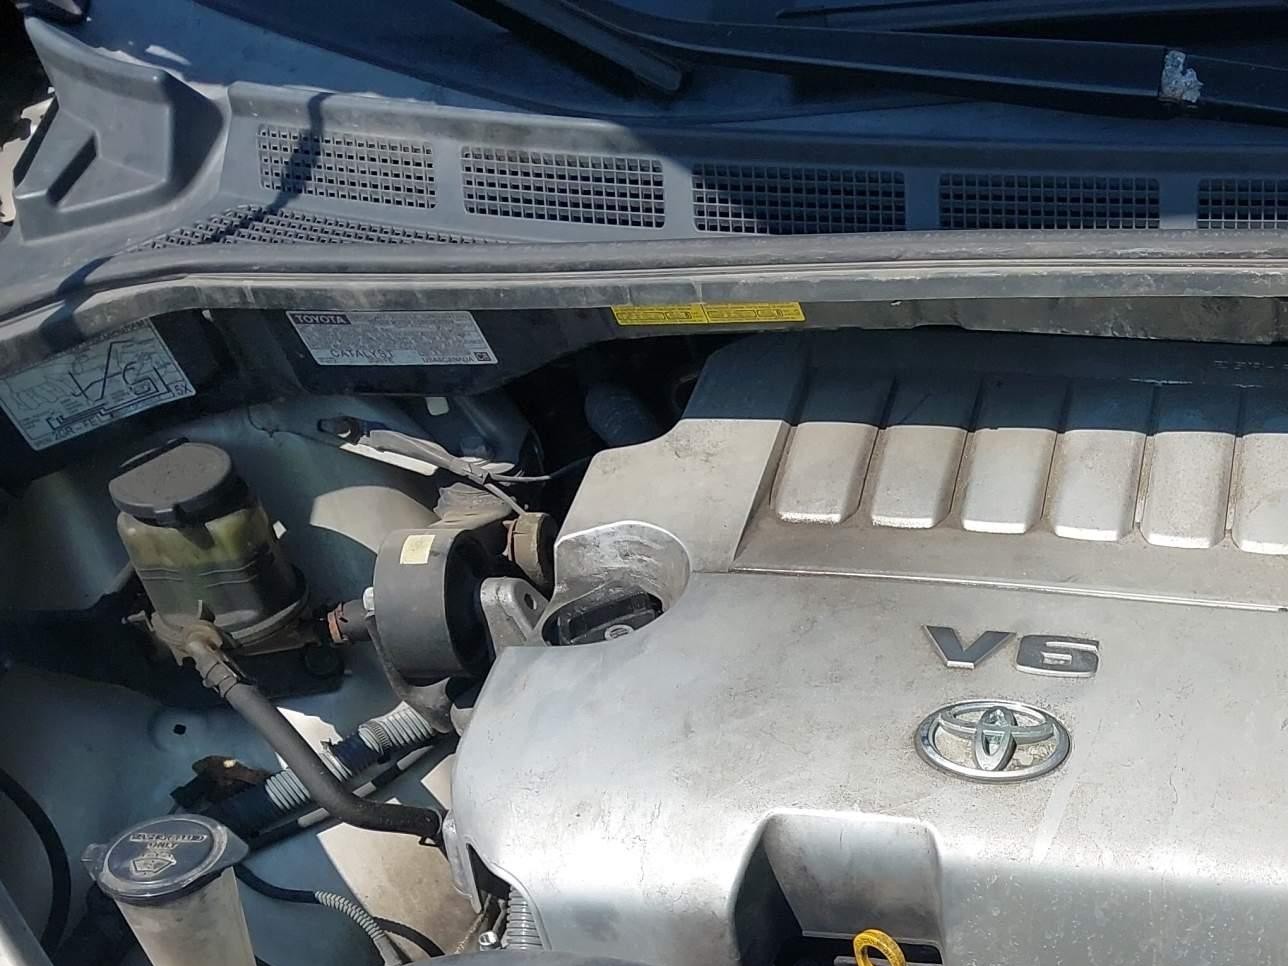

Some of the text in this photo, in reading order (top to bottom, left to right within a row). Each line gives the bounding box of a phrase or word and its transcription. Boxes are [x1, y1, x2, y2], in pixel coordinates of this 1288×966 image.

[294, 313, 347, 323] TOYOTA
[330, 349, 393, 361] CATALYST
[922, 624, 1100, 678] V6
